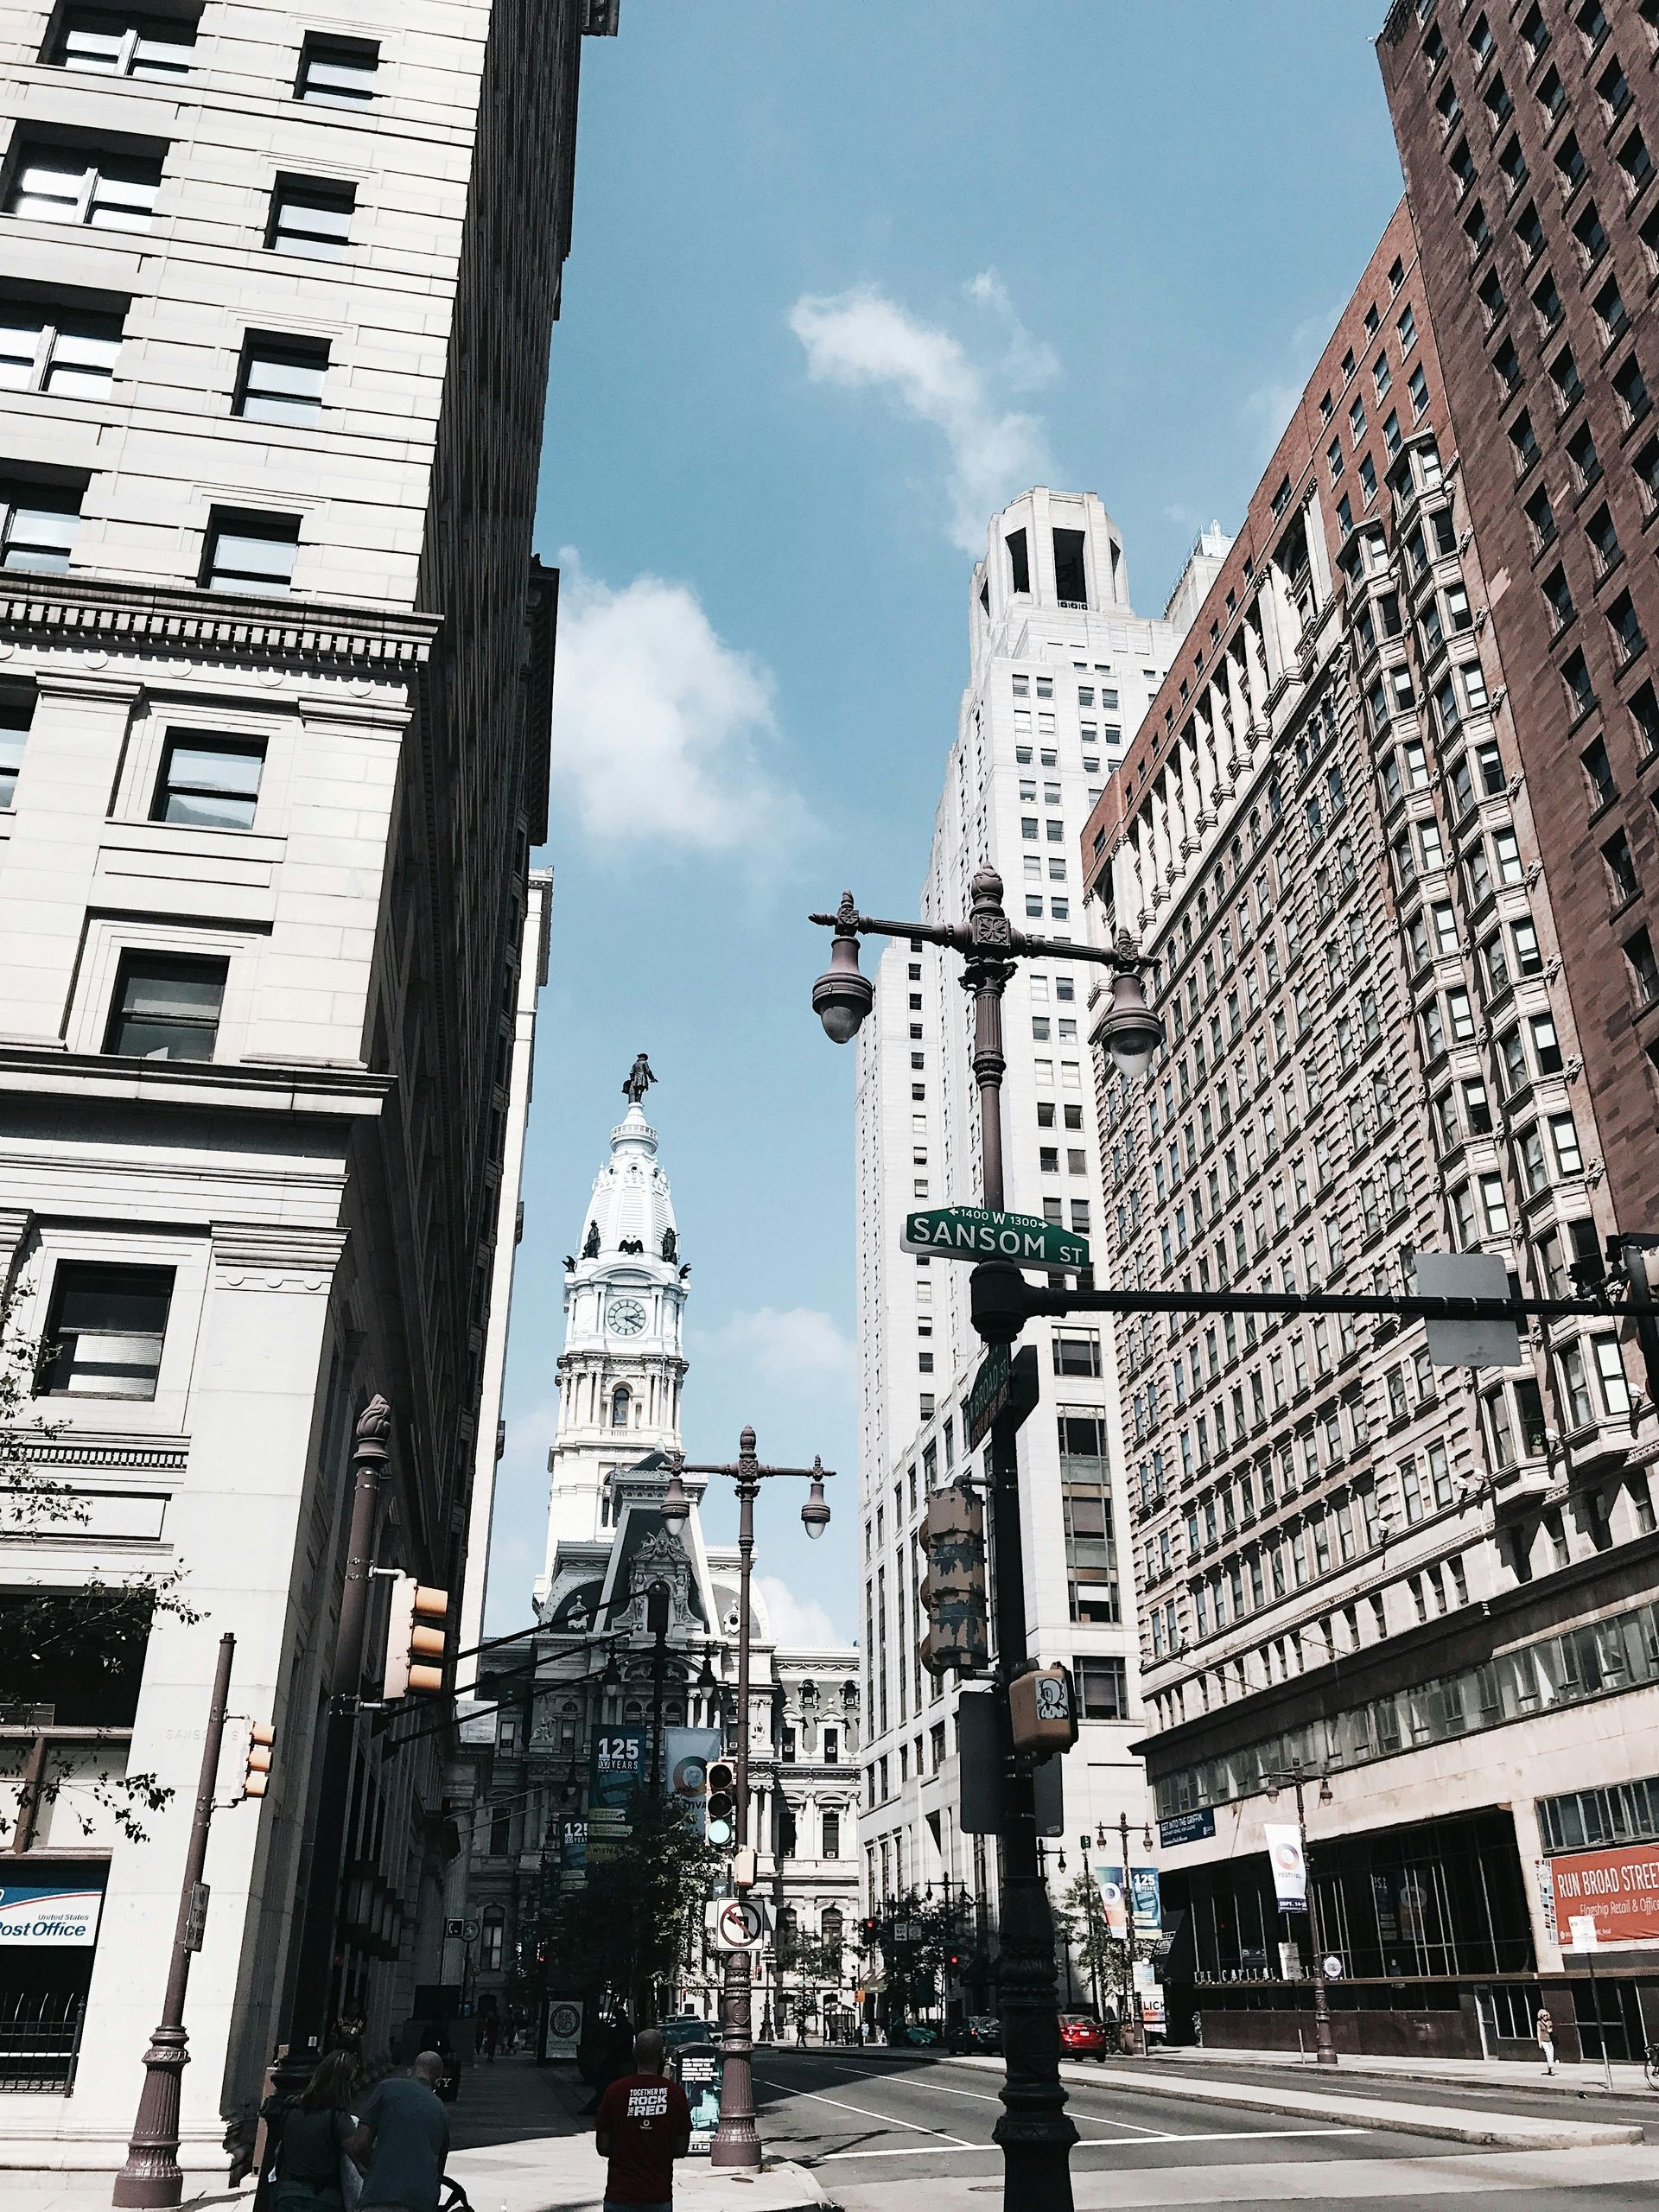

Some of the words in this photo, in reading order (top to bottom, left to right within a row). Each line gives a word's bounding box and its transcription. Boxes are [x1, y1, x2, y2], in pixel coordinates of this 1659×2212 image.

[961, 1209, 988, 1221] 1400
[993, 1212, 1006, 1225] W
[1010, 1216, 1038, 1228] 1300
[913, 1217, 1046, 1259] SANSOM
[1059, 1246, 1083, 1264] ST
[975, 1363, 998, 1419] BROAD
[598, 1738, 639, 1760] 125
[611, 1760, 639, 1770] YEARS
[1134, 1873, 1156, 1887] 125
[1557, 1872, 1581, 1898] RUN
[1581, 1866, 1621, 1896] BROAD
[1580, 1902, 1609, 1919] Flagship
[1610, 1899, 1631, 1915] Retail
[1631, 1898, 1638, 1913] &
[32, 1921, 86, 1936] Office
[628, 2094, 668, 2107] ROCK
[629, 2088, 658, 2097] TOGETHER
[658, 2087, 669, 2095] WE
[633, 2104, 668, 2117] RED
